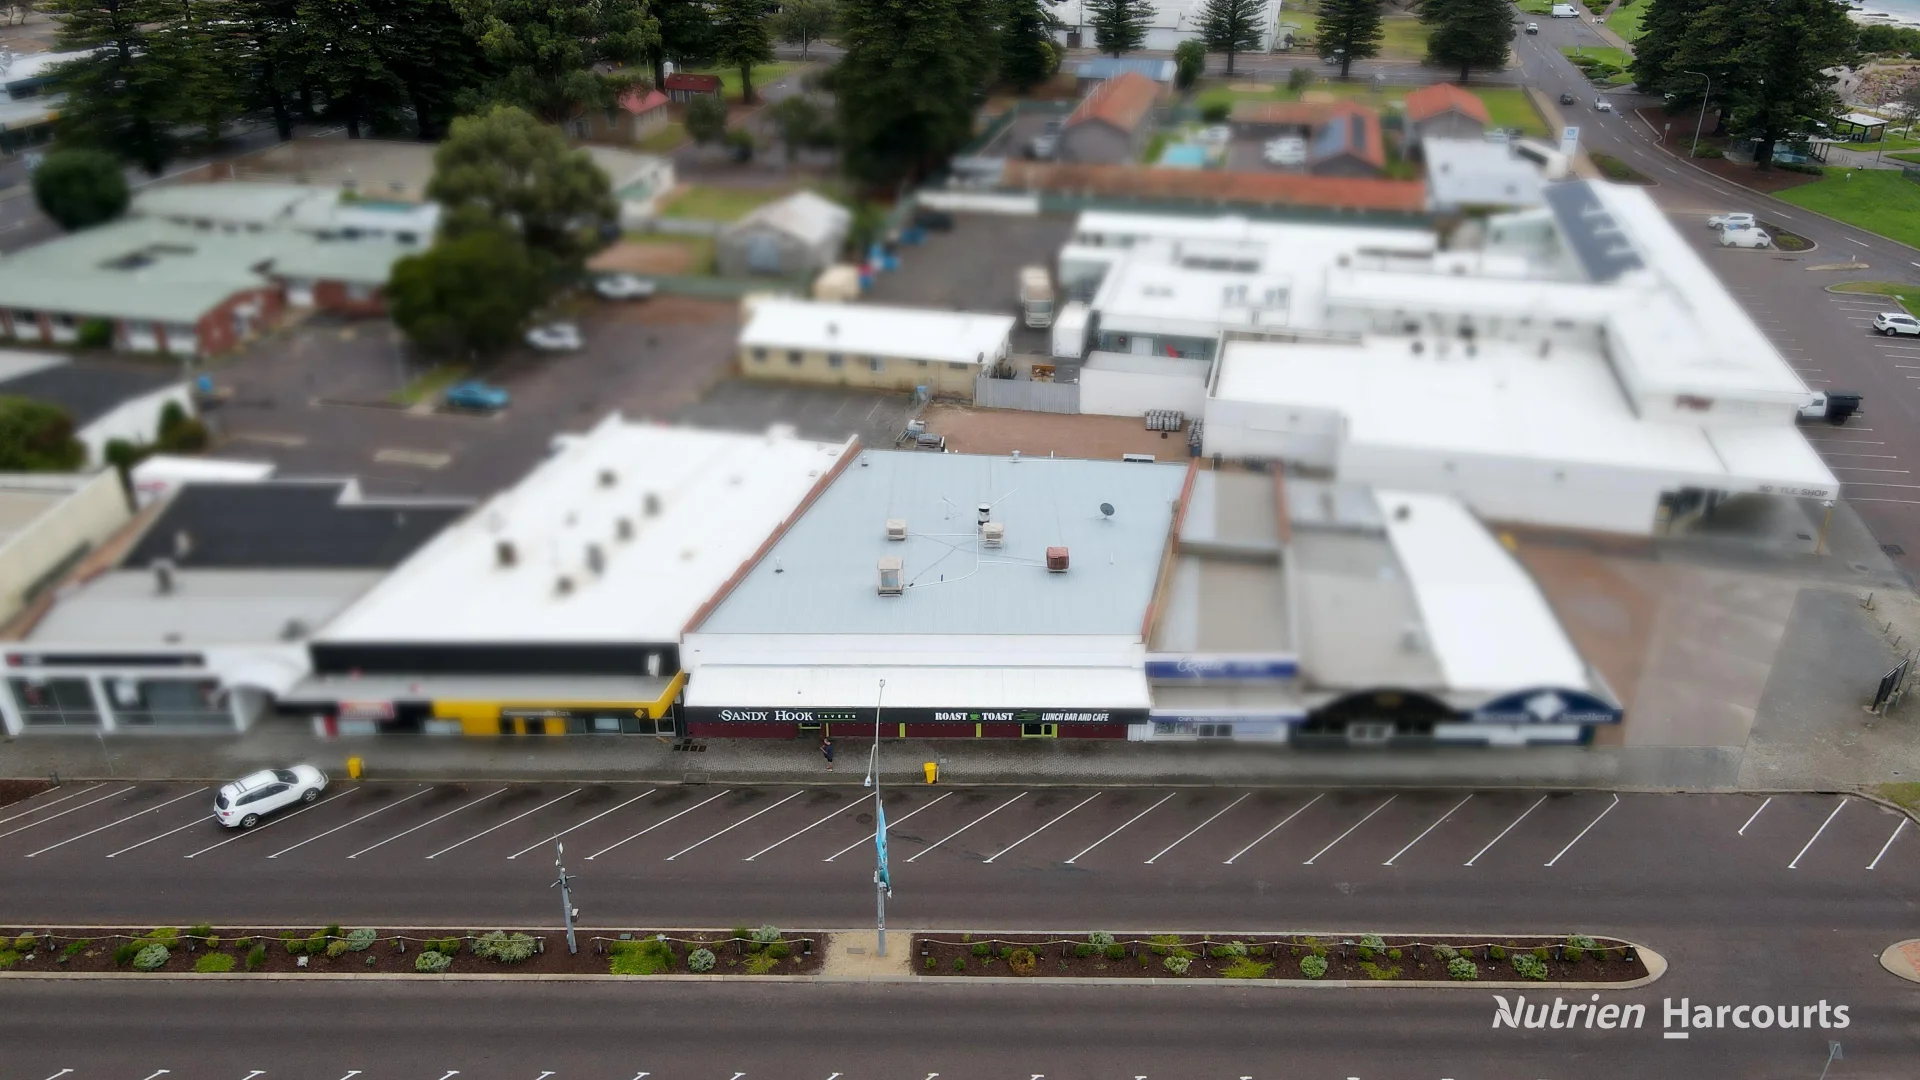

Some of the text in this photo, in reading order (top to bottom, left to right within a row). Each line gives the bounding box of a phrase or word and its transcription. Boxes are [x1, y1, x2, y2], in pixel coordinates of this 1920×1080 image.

[1801, 488, 1828, 497] SHOP
[720, 709, 769, 721] SANDY
[774, 710, 813, 721] HOOK
[935, 712, 1014, 721] ROAST TOAST
[1041, 712, 1109, 721] LUNCH BAR AND CAFE
